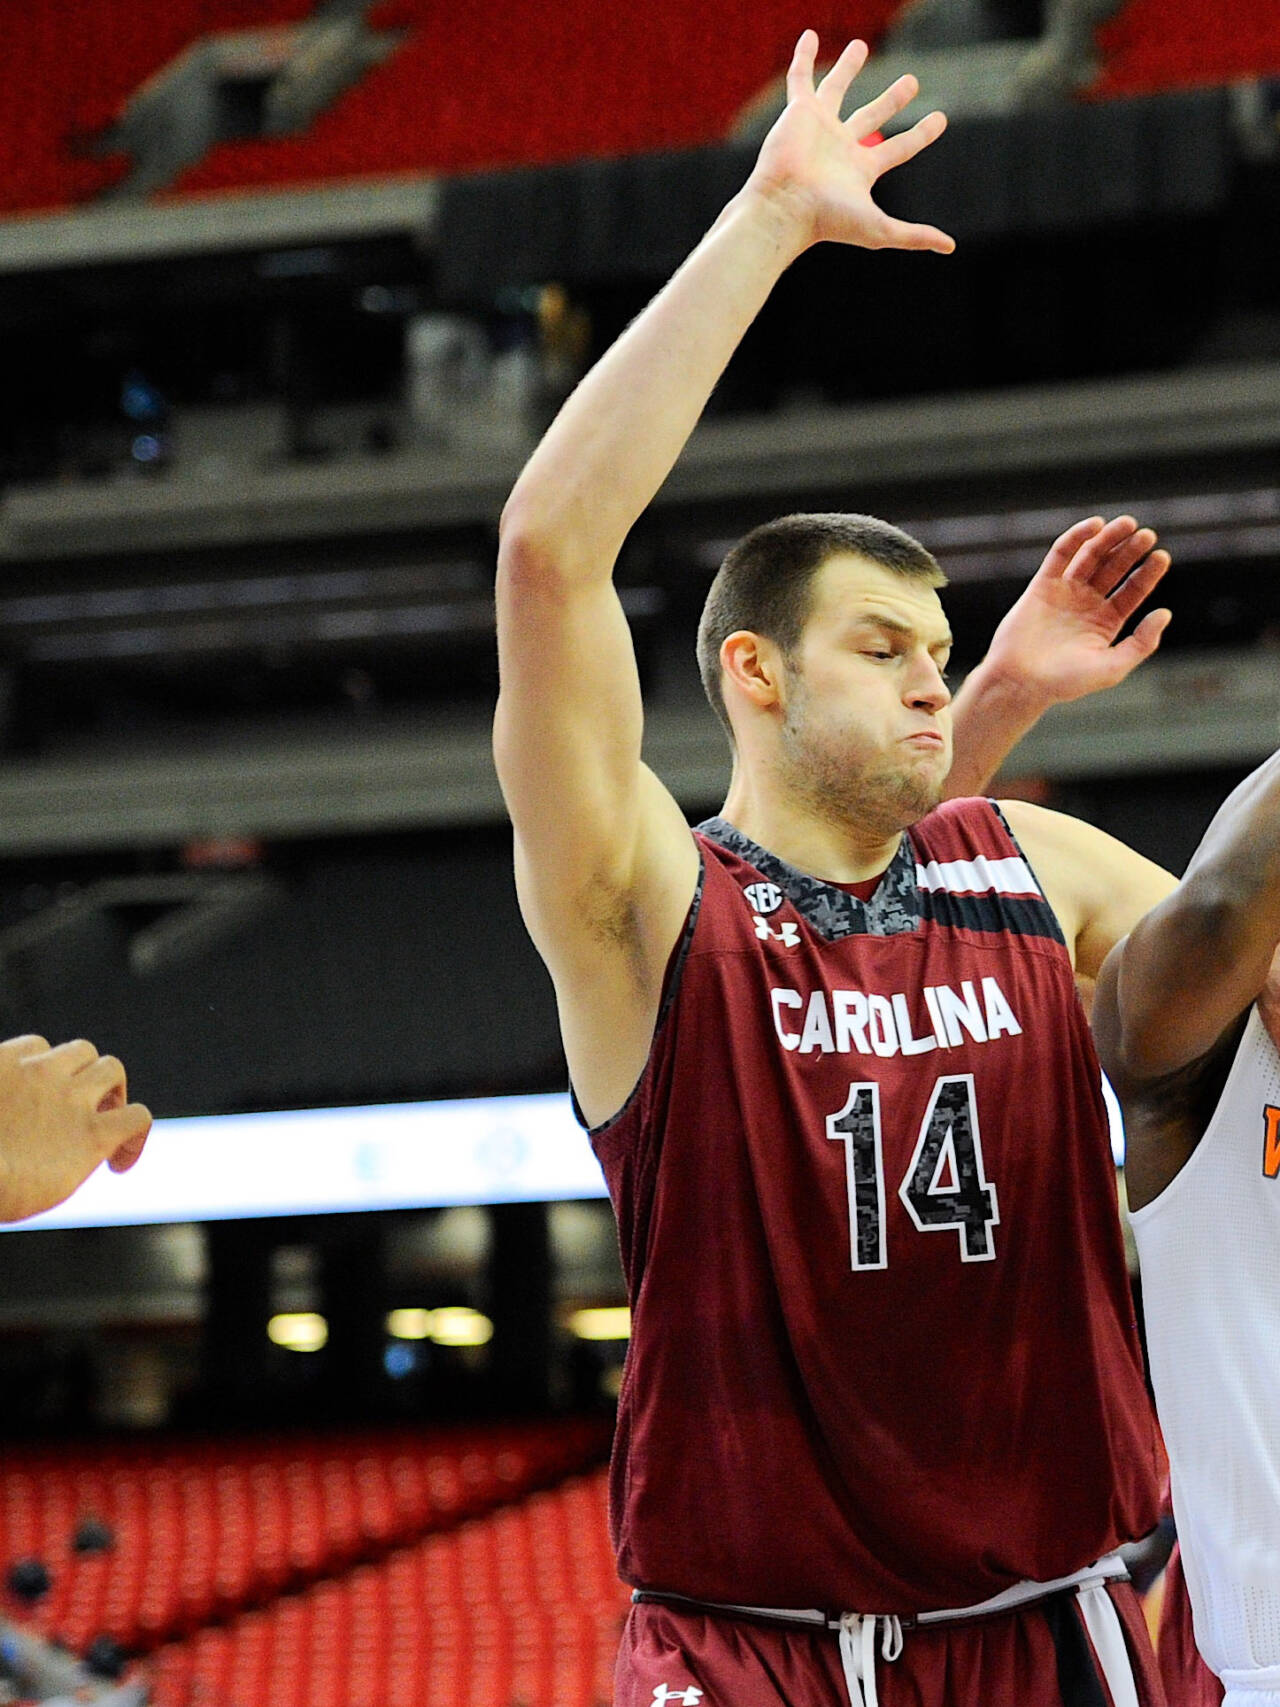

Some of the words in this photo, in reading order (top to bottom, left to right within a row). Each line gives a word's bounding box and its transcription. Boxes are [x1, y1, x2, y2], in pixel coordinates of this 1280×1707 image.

[742, 882, 783, 914] SEC
[770, 977, 1022, 1058] CAROLINA
[825, 1073, 1000, 1271] 14
